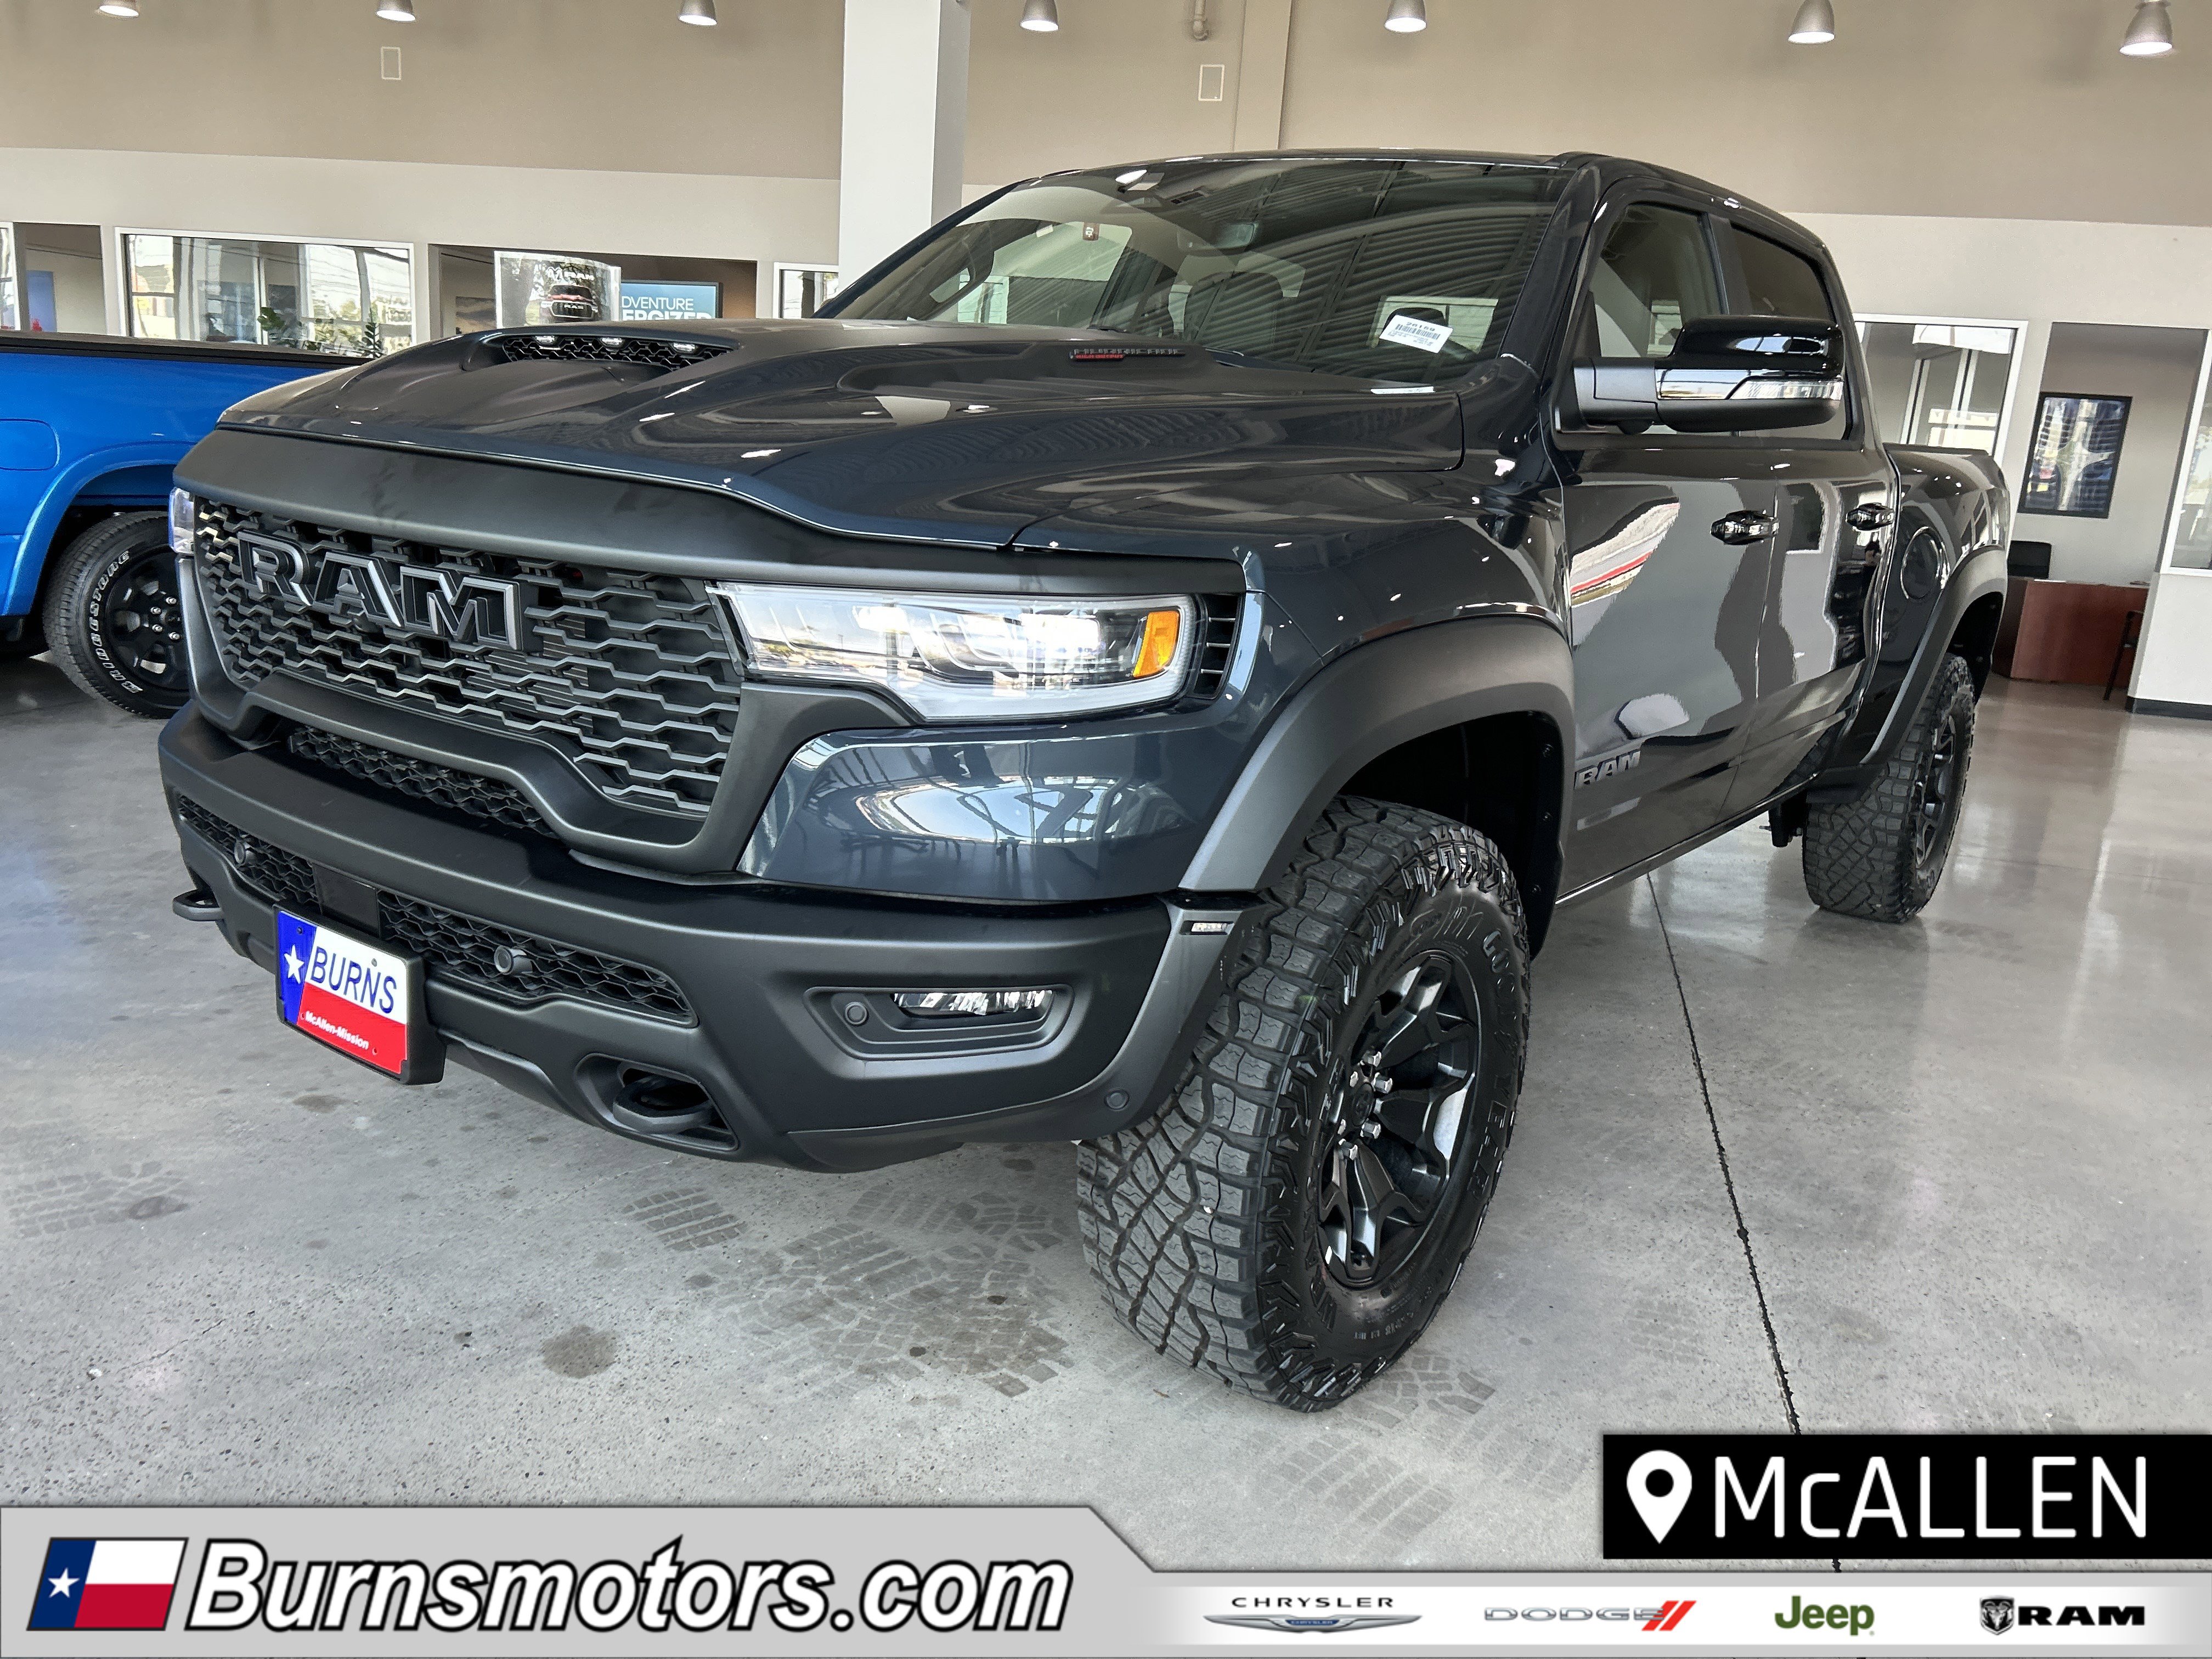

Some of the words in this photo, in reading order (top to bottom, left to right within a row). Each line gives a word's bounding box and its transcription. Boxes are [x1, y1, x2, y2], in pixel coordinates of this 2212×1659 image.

[564, 271, 594, 281] RAM
[622, 296, 693, 311] DVENTURE
[237, 529, 524, 651] RAM
[1573, 749, 1641, 790] RAM
[311, 946, 397, 1014] BURNS
[305, 1011, 369, 1050] McAllen-Mission
